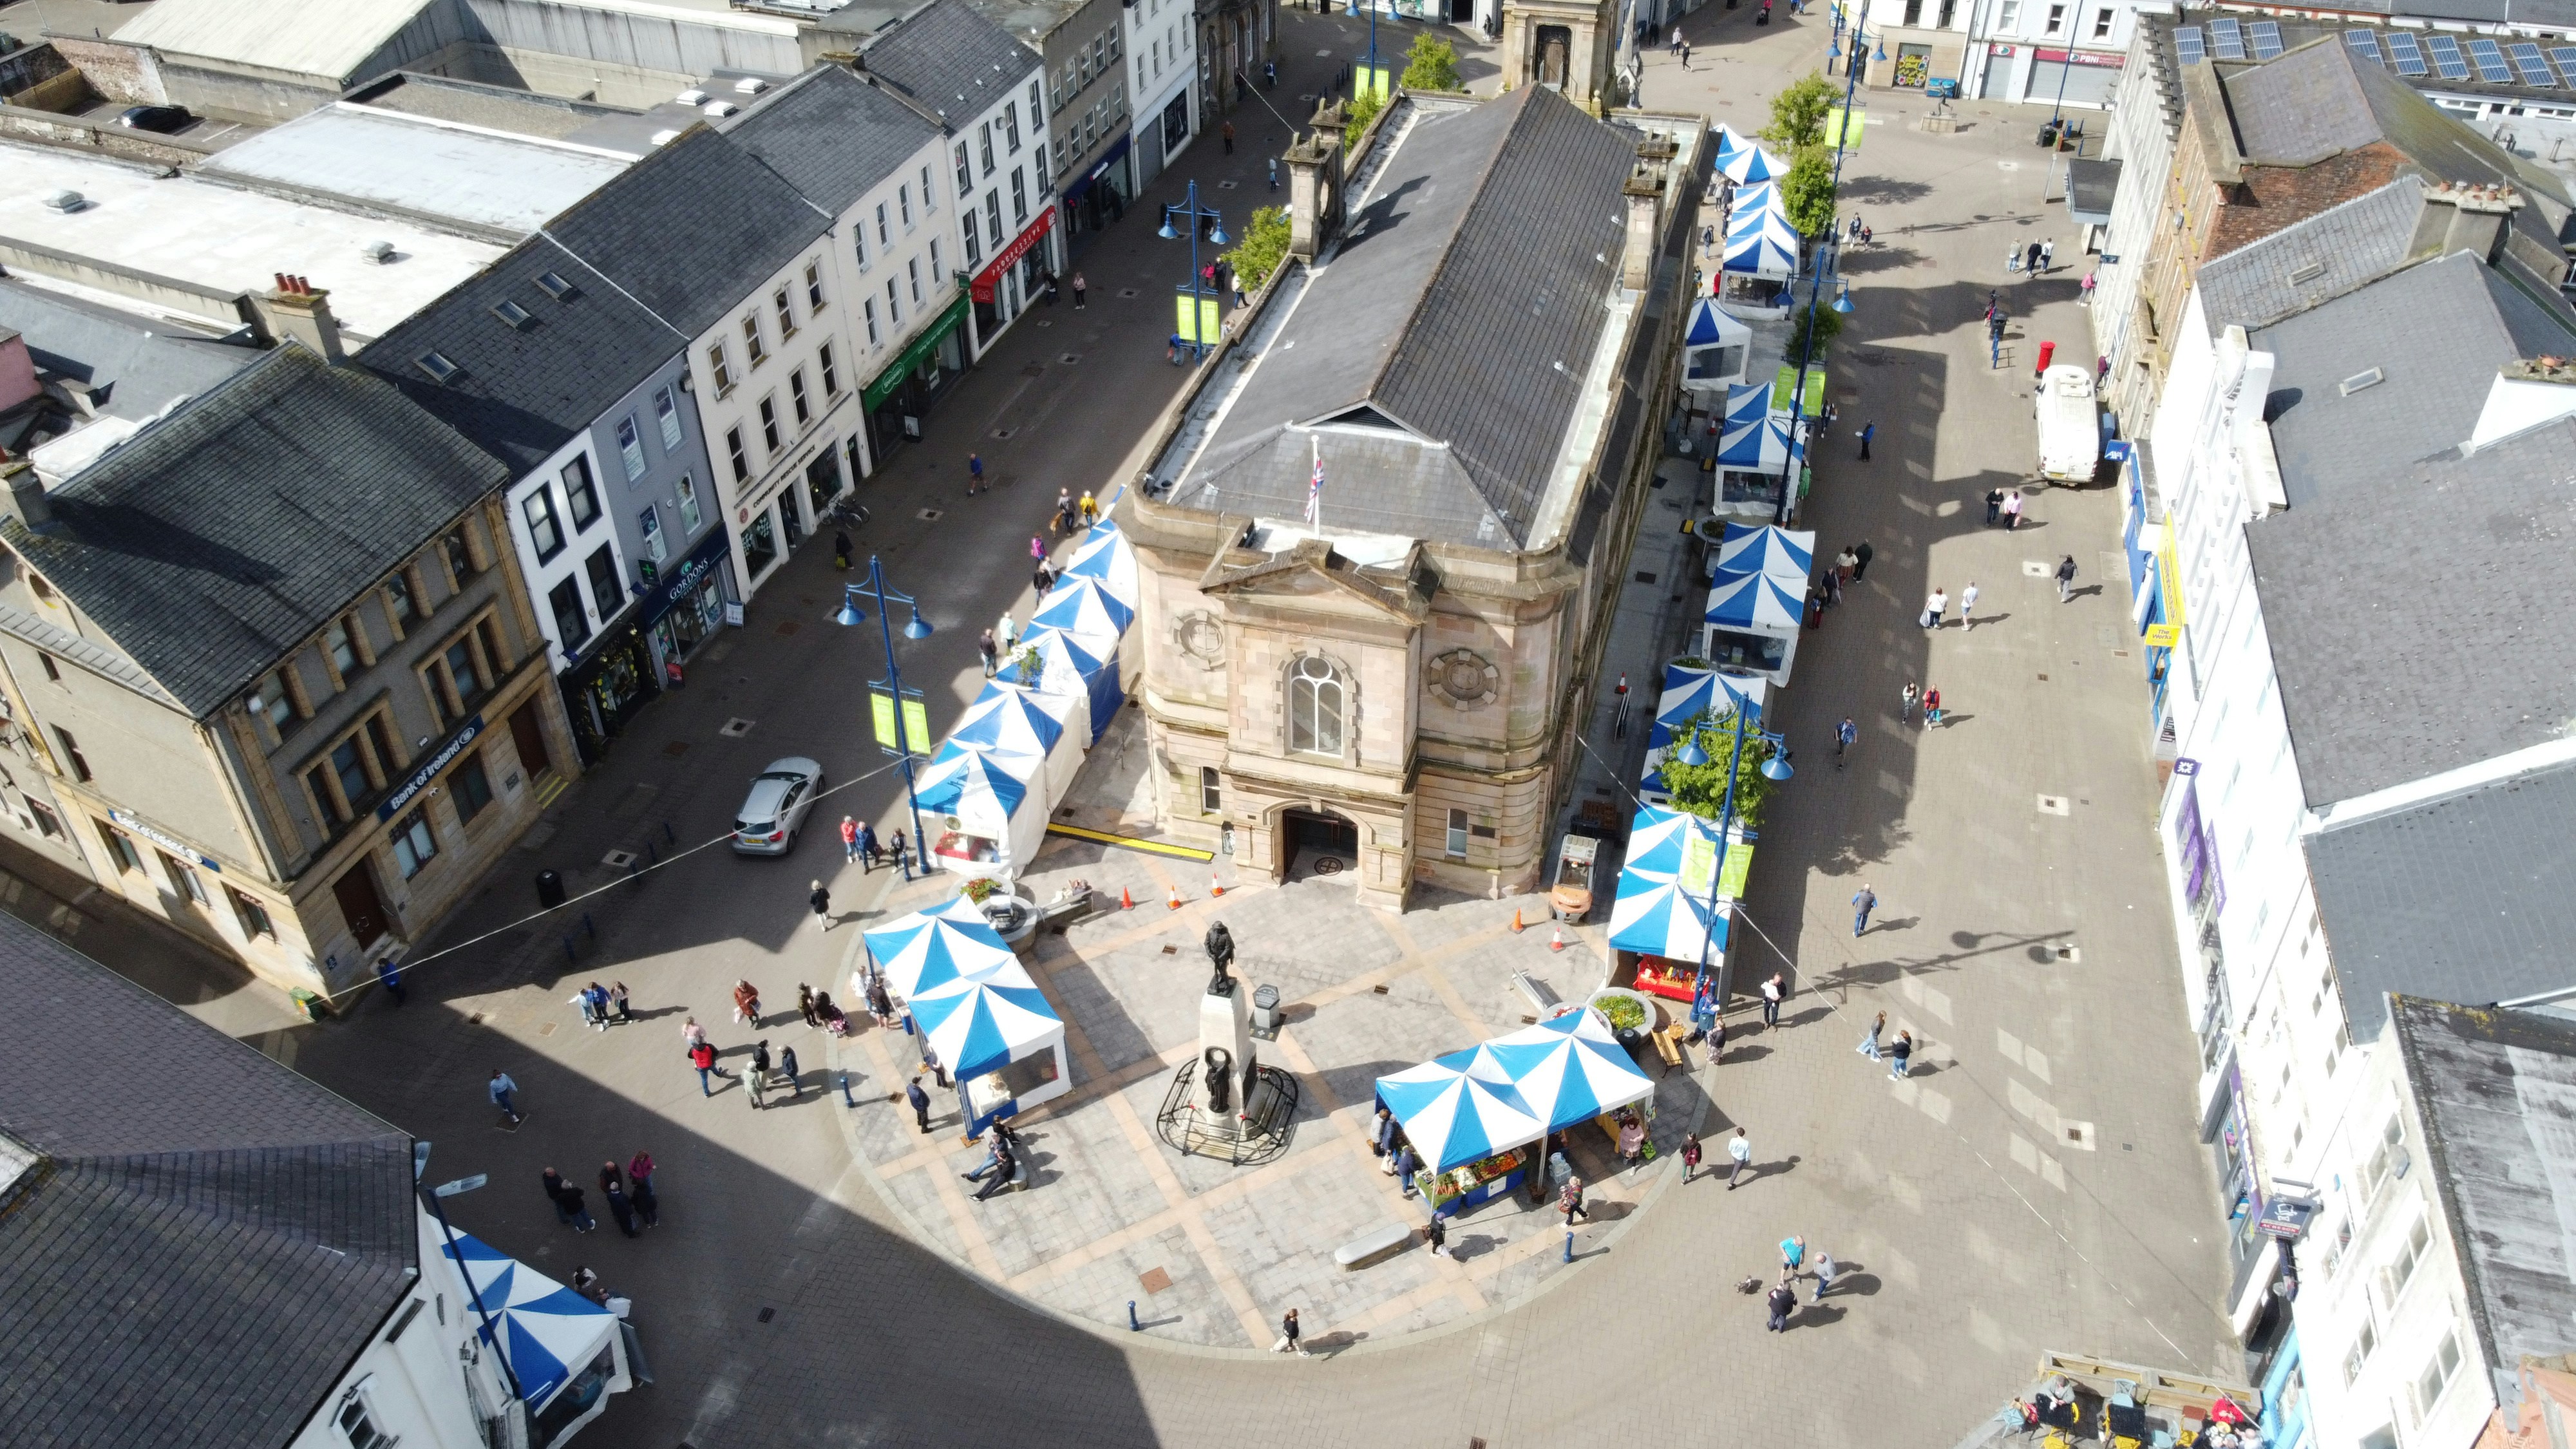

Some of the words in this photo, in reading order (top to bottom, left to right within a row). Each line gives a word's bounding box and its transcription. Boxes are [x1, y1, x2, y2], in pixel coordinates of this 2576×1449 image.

[2079, 55, 2099, 63] PBNI
[992, 226, 1040, 276] PROGRESSIVE
[753, 478, 780, 508] COMMUNITY
[780, 462, 797, 482] RESCUE
[798, 444, 815, 465] SERVICE
[670, 557, 708, 600] GORDONS
[391, 781, 418, 810] Bank
[416, 769, 427, 786] of
[426, 740, 460, 776] Ireland
[2213, 872, 2222, 908] Bank
